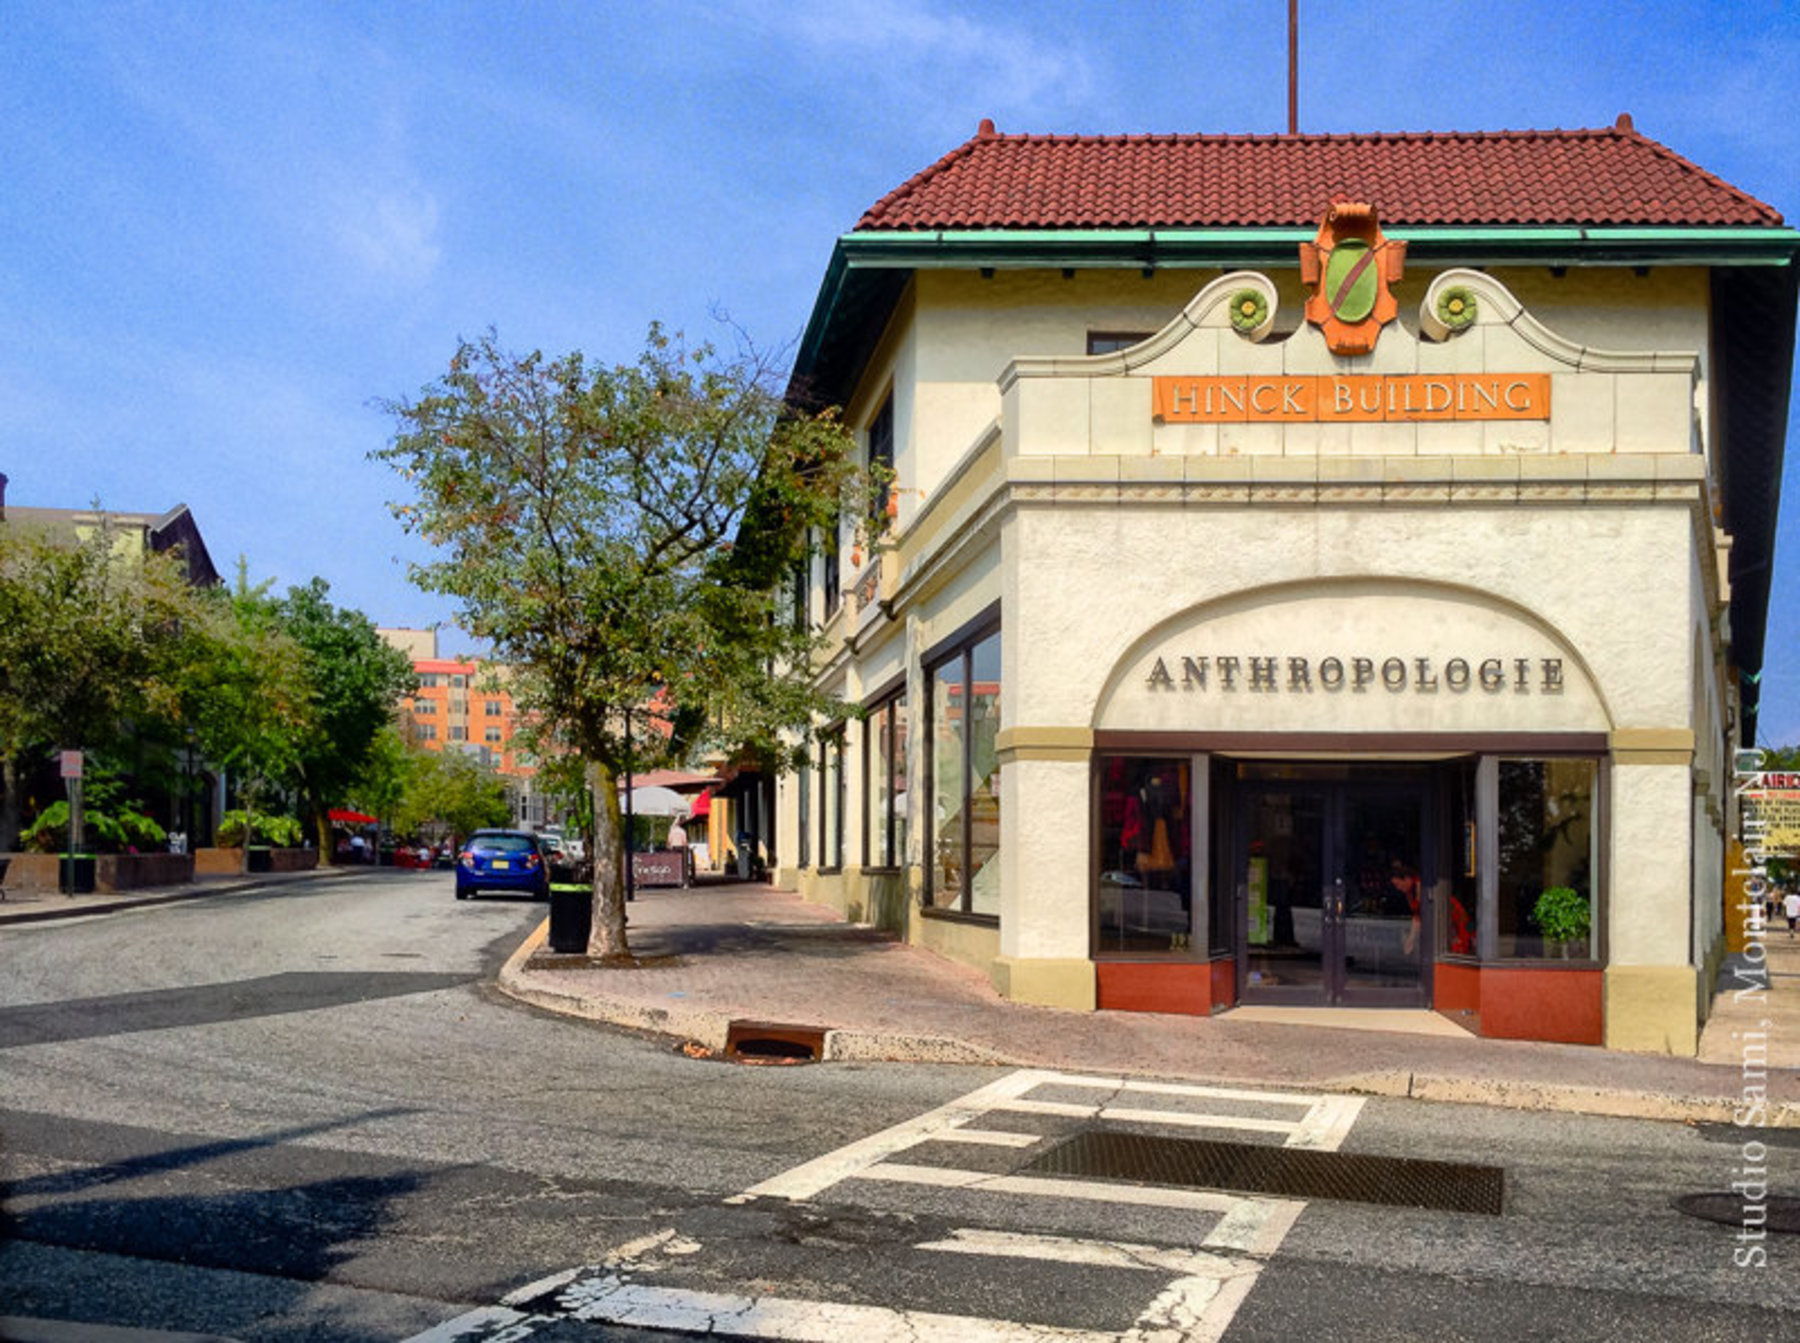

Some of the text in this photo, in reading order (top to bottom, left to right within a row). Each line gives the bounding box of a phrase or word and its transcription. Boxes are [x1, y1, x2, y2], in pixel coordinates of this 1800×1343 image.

[1172, 382, 1532, 415] HINCK BUILDING
[1145, 656, 1565, 688] ANTHROPOLOGIE
